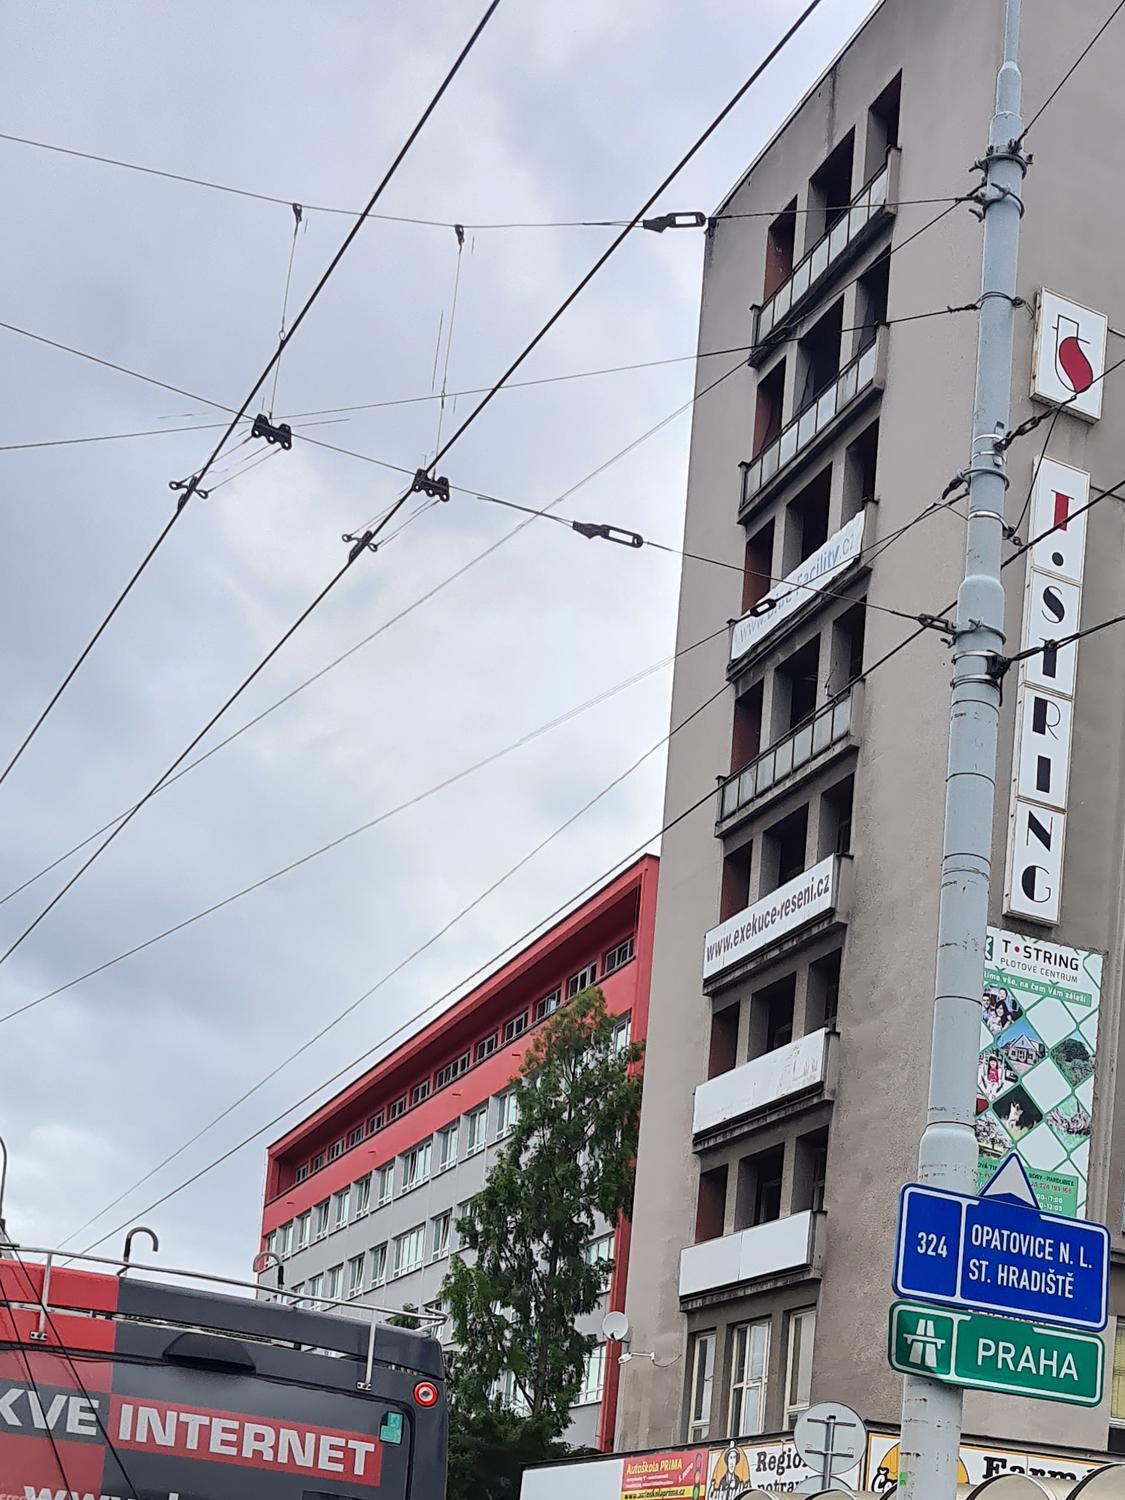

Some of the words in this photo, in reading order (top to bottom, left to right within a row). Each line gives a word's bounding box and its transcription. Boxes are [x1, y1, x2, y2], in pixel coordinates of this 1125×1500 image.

[706, 874, 830, 963] www.exekuce-reseni.cz
[1040, 967, 1078, 983] CENTRUM
[917, 1231, 948, 1258] 324
[971, 1223, 1054, 1261] OPATOVICE
[1059, 1242, 1074, 1265] N.
[1079, 1246, 1093, 1269] L.
[968, 1258, 991, 1283] ST.
[997, 1264, 1075, 1299] HRADIŠTĚ
[976, 1337, 1079, 1381] PRAHA
[0, 1388, 99, 1437] KVE
[118, 1403, 376, 1476] INTERNET
[660, 1458, 682, 1472] PRIMA
[756, 1447, 808, 1476] Regio
